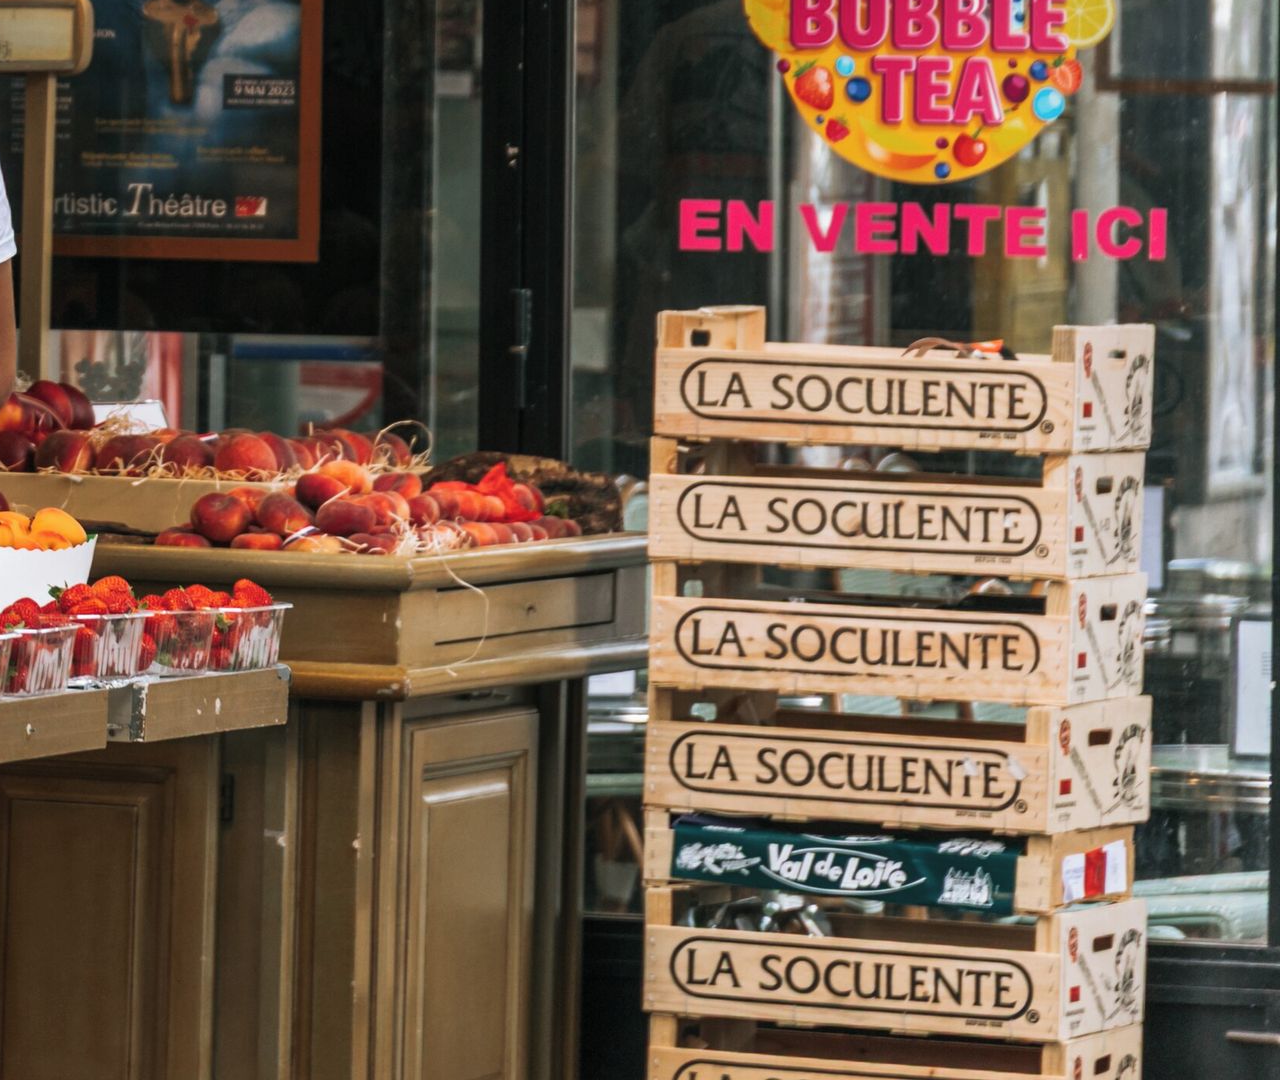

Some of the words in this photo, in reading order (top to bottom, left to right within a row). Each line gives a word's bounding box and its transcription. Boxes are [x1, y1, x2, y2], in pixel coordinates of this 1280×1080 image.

[244, 85, 266, 97] MAI
[267, 85, 297, 98] 2023
[873, 57, 1005, 124] TEA
[54, 193, 118, 216] rtistic
[122, 181, 228, 218] Théâtre
[678, 200, 776, 252] EN
[800, 202, 1047, 256] VENTE
[1071, 209, 1169, 261] ICI
[696, 371, 753, 409] LA
[770, 374, 1032, 421] SOCULENTE
[693, 494, 745, 531] LA
[766, 497, 1025, 545] SOCULENTE
[690, 618, 746, 658] LA
[764, 623, 1025, 671] SOCULENTE
[684, 743, 735, 781] LA
[755, 748, 1005, 800] SOCULENTE
[768, 843, 809, 882] Val
[814, 852, 843, 882] de
[841, 857, 908, 890] Loire
[687, 949, 740, 988] LA
[759, 954, 1017, 1010] SOCULENTE
